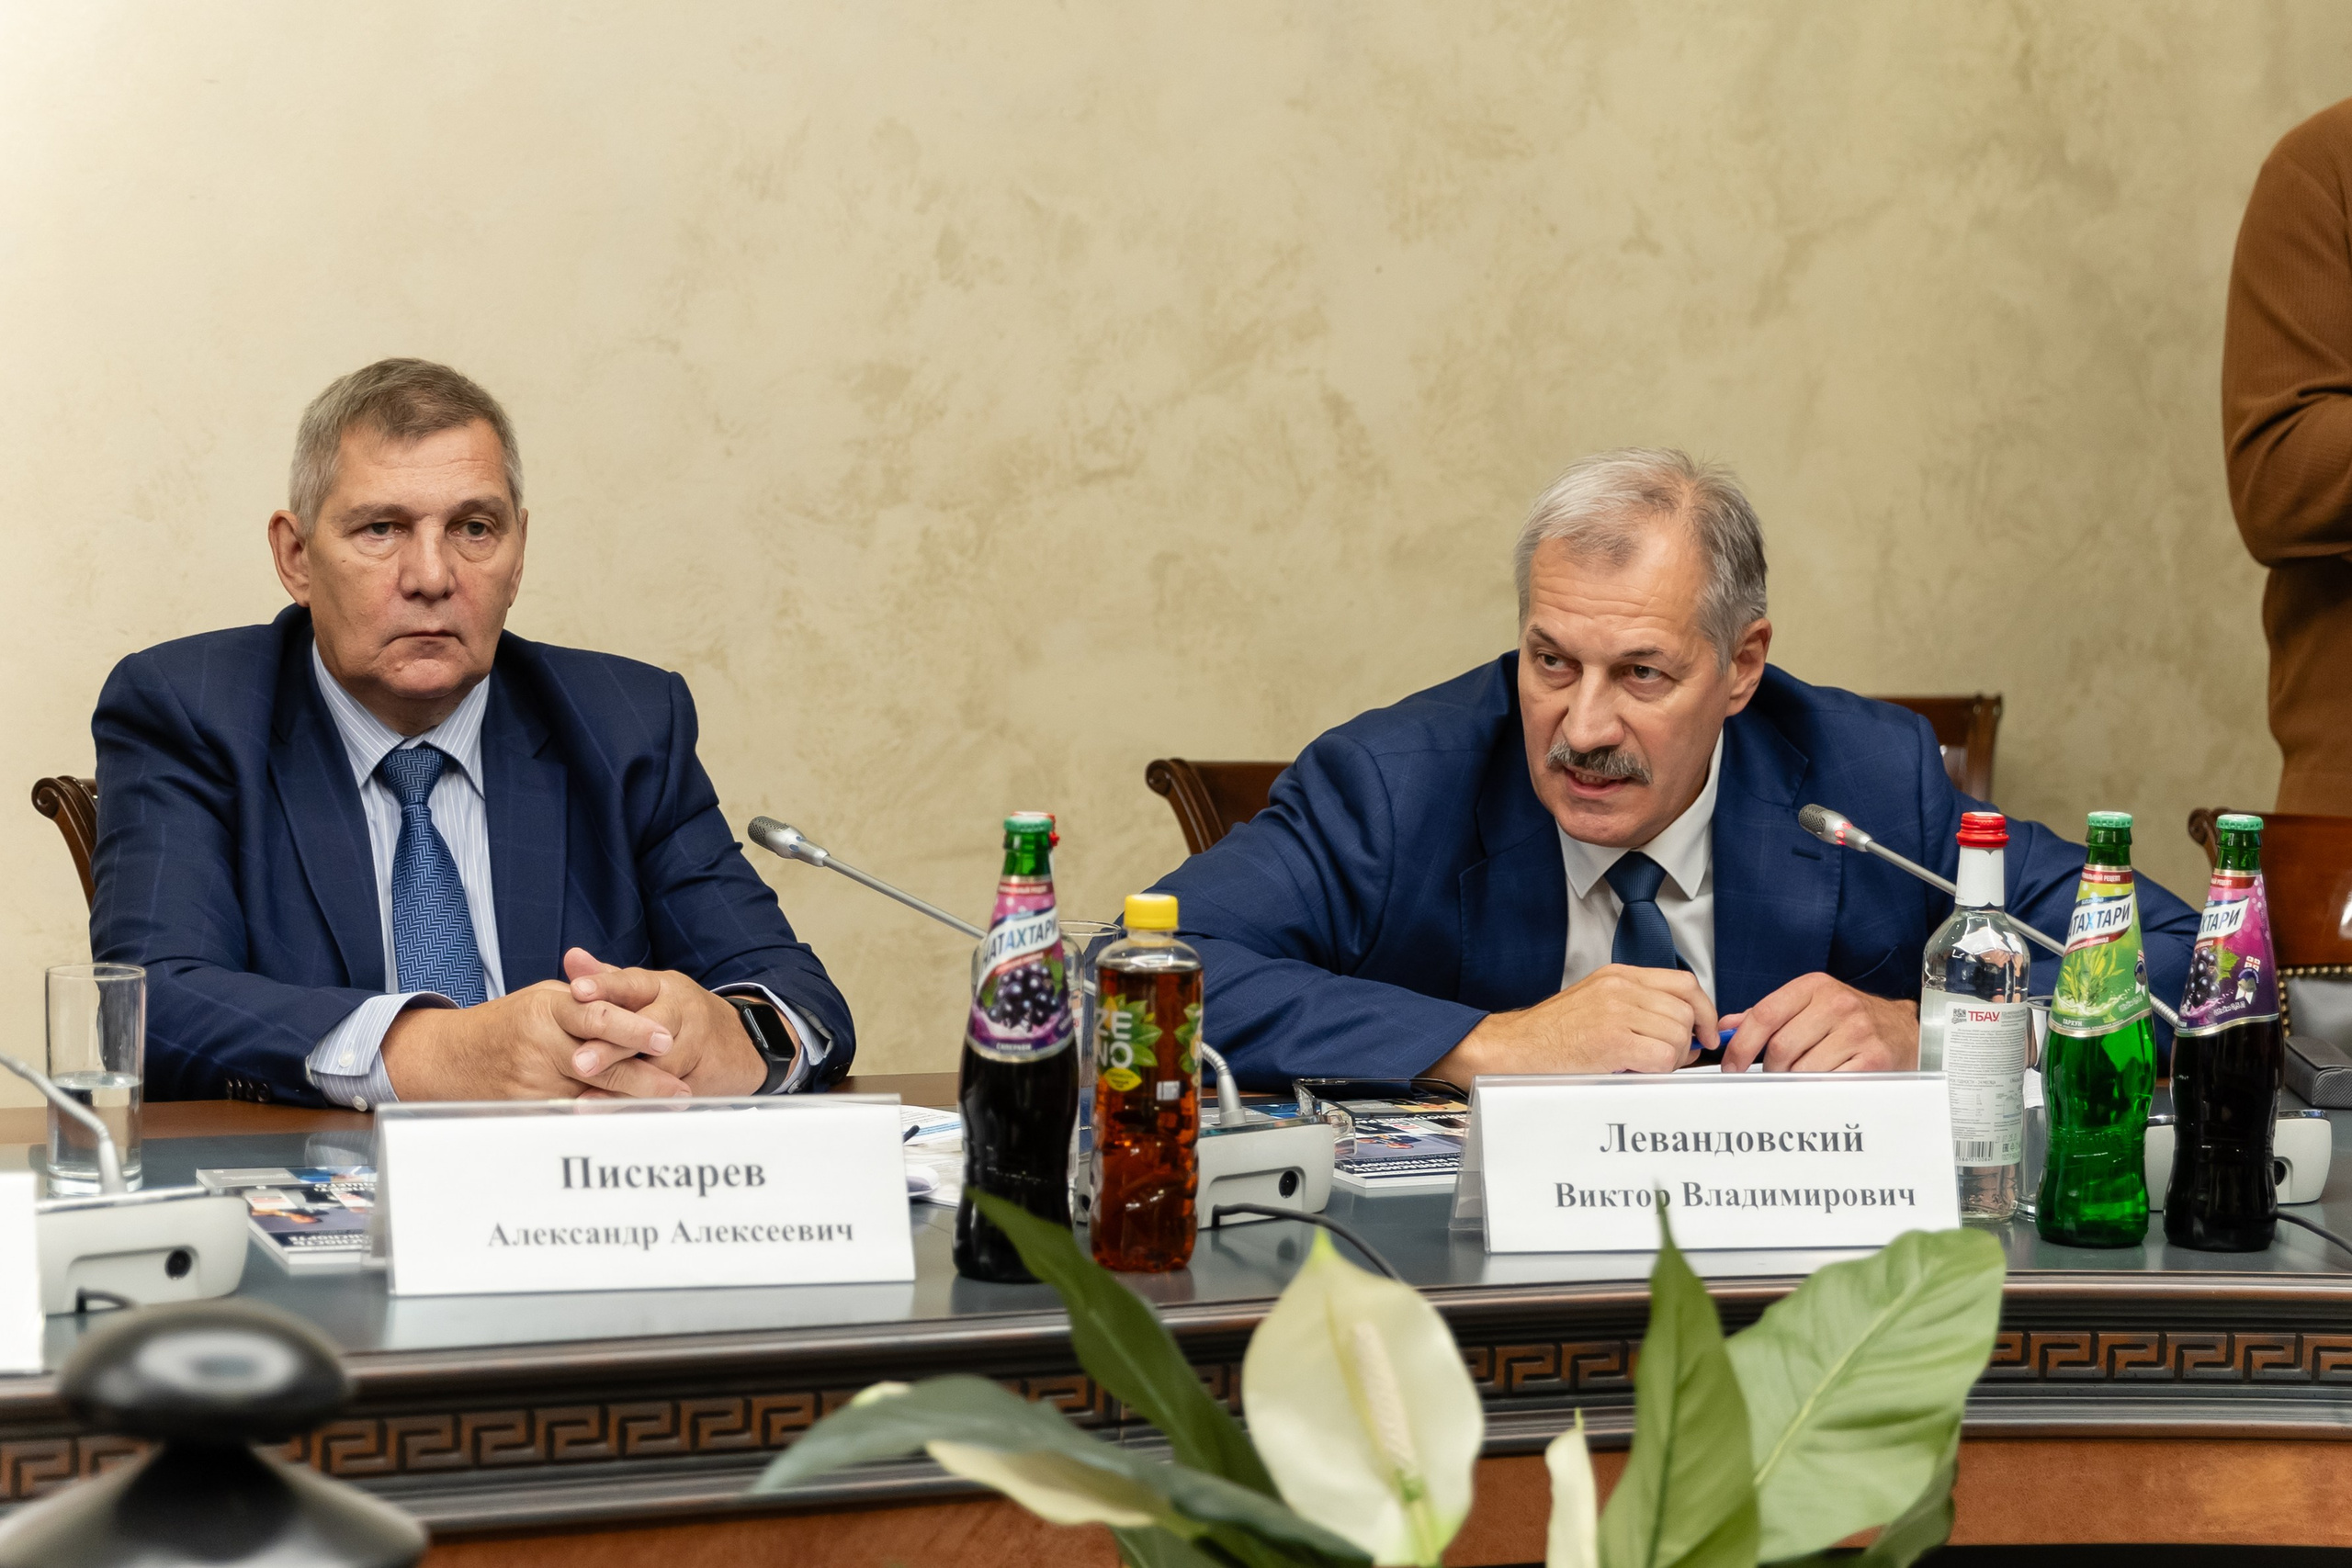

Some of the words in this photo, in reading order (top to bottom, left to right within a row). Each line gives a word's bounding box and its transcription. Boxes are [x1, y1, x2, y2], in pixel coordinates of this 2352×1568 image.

[1968, 1010, 2000, 1021] ТБАУ
[1600, 1122, 1864, 1156] Левандовский
[560, 1156, 766, 1197] Пискарев
[1555, 1182, 1670, 1214] Виктор
[1681, 1181, 1917, 1213] Владимирович
[488, 1222, 659, 1250] Александр
[671, 1219, 854, 1244] Алексеевич
